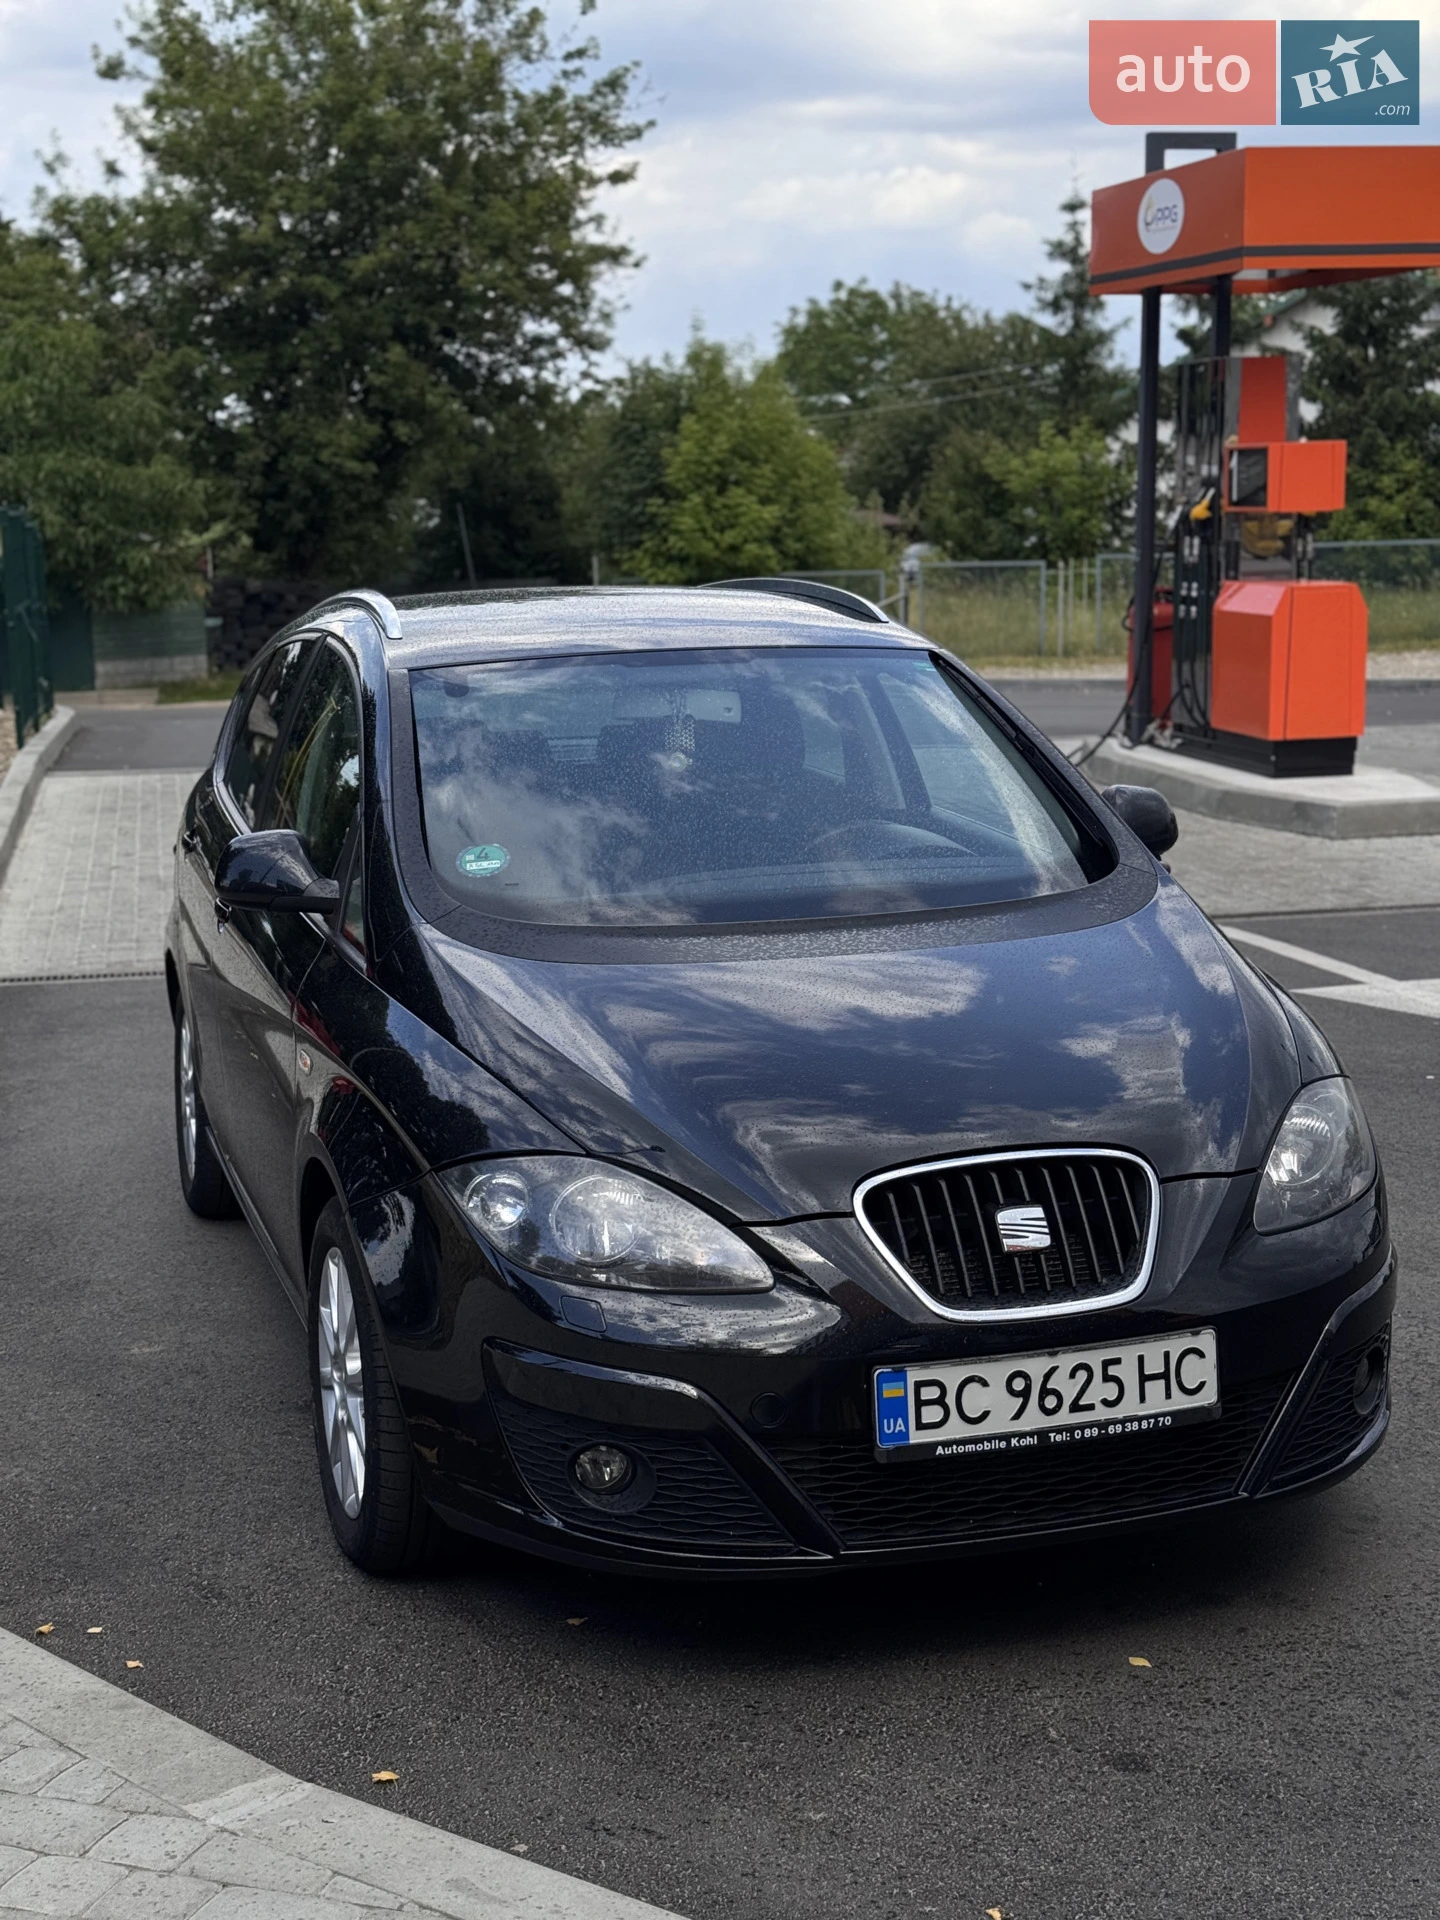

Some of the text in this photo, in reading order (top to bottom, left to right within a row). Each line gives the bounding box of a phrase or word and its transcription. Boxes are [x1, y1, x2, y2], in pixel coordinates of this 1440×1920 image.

[477, 847, 490, 860] 4
[913, 1346, 1207, 1431] BC 9625 HC
[883, 1417, 906, 1434] UA
[936, 1440, 1007, 1455] Automobile
[1011, 1435, 1038, 1447] Kohl
[1048, 1432, 1071, 1442] Tel:
